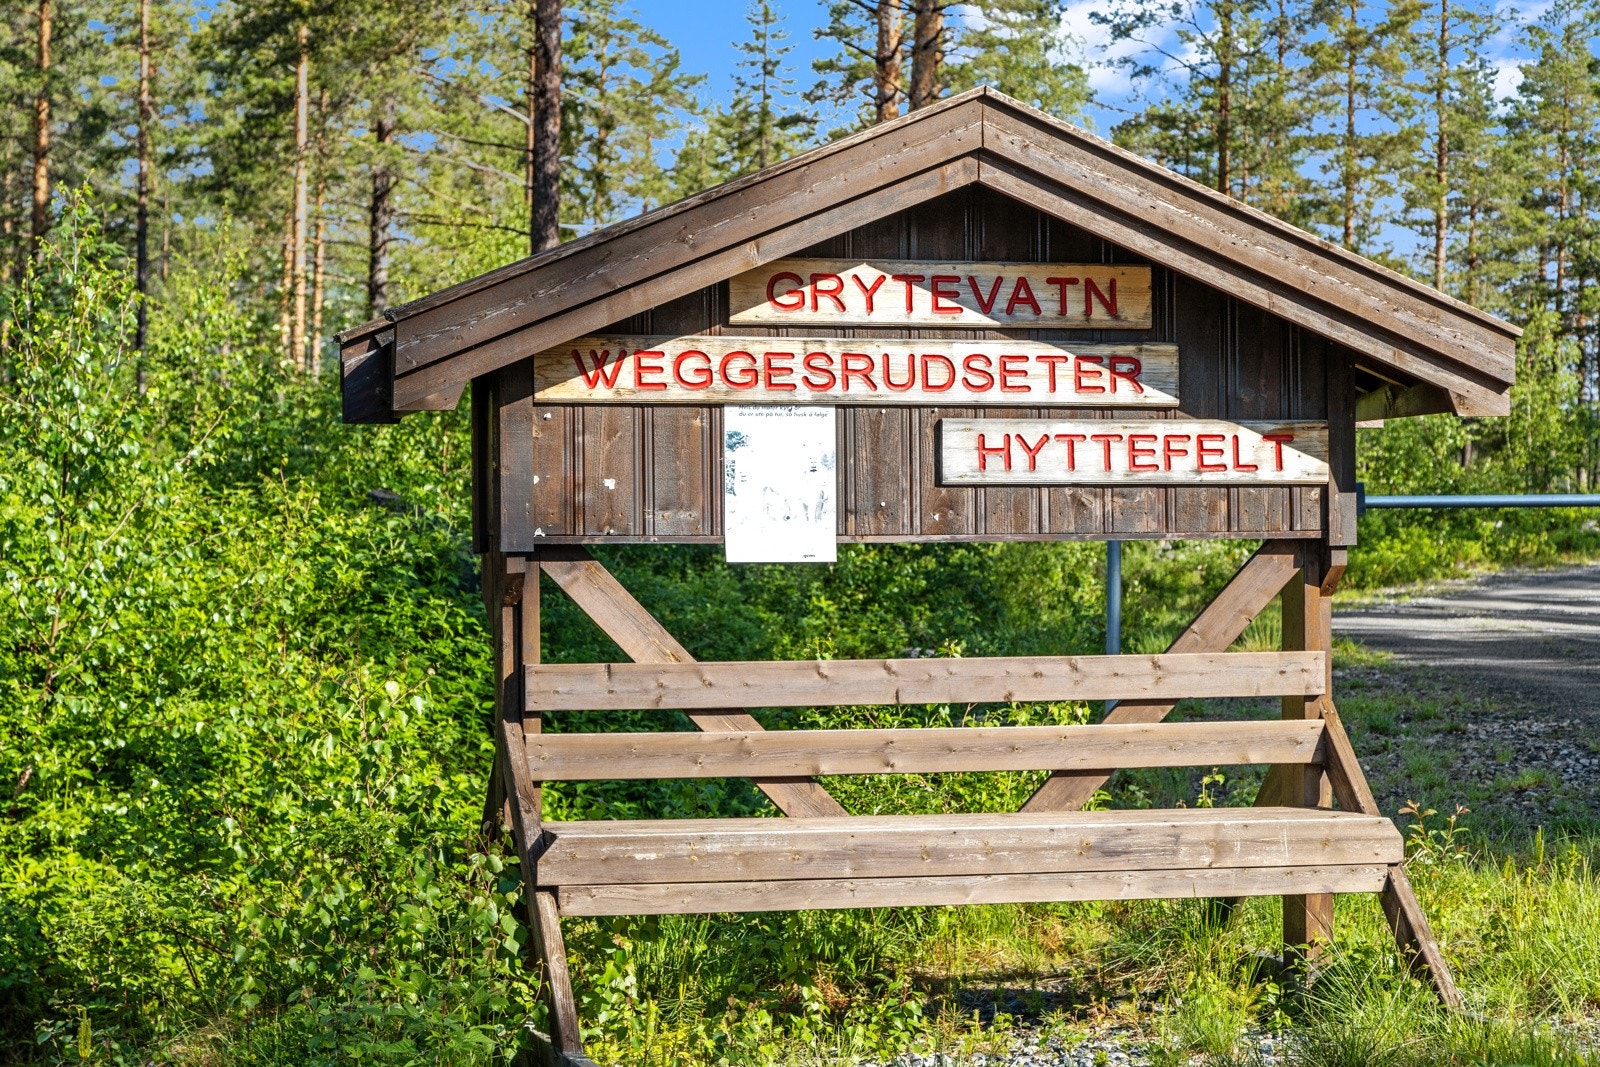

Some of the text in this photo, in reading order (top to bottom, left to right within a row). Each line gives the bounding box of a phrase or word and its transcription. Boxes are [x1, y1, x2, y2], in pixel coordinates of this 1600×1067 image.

[766, 271, 1120, 317] GRYTEVATN
[571, 349, 1144, 395] WEGGESRUDSETER
[814, 411, 828, 419] følge
[976, 432, 1295, 473] HYTTEFELT
